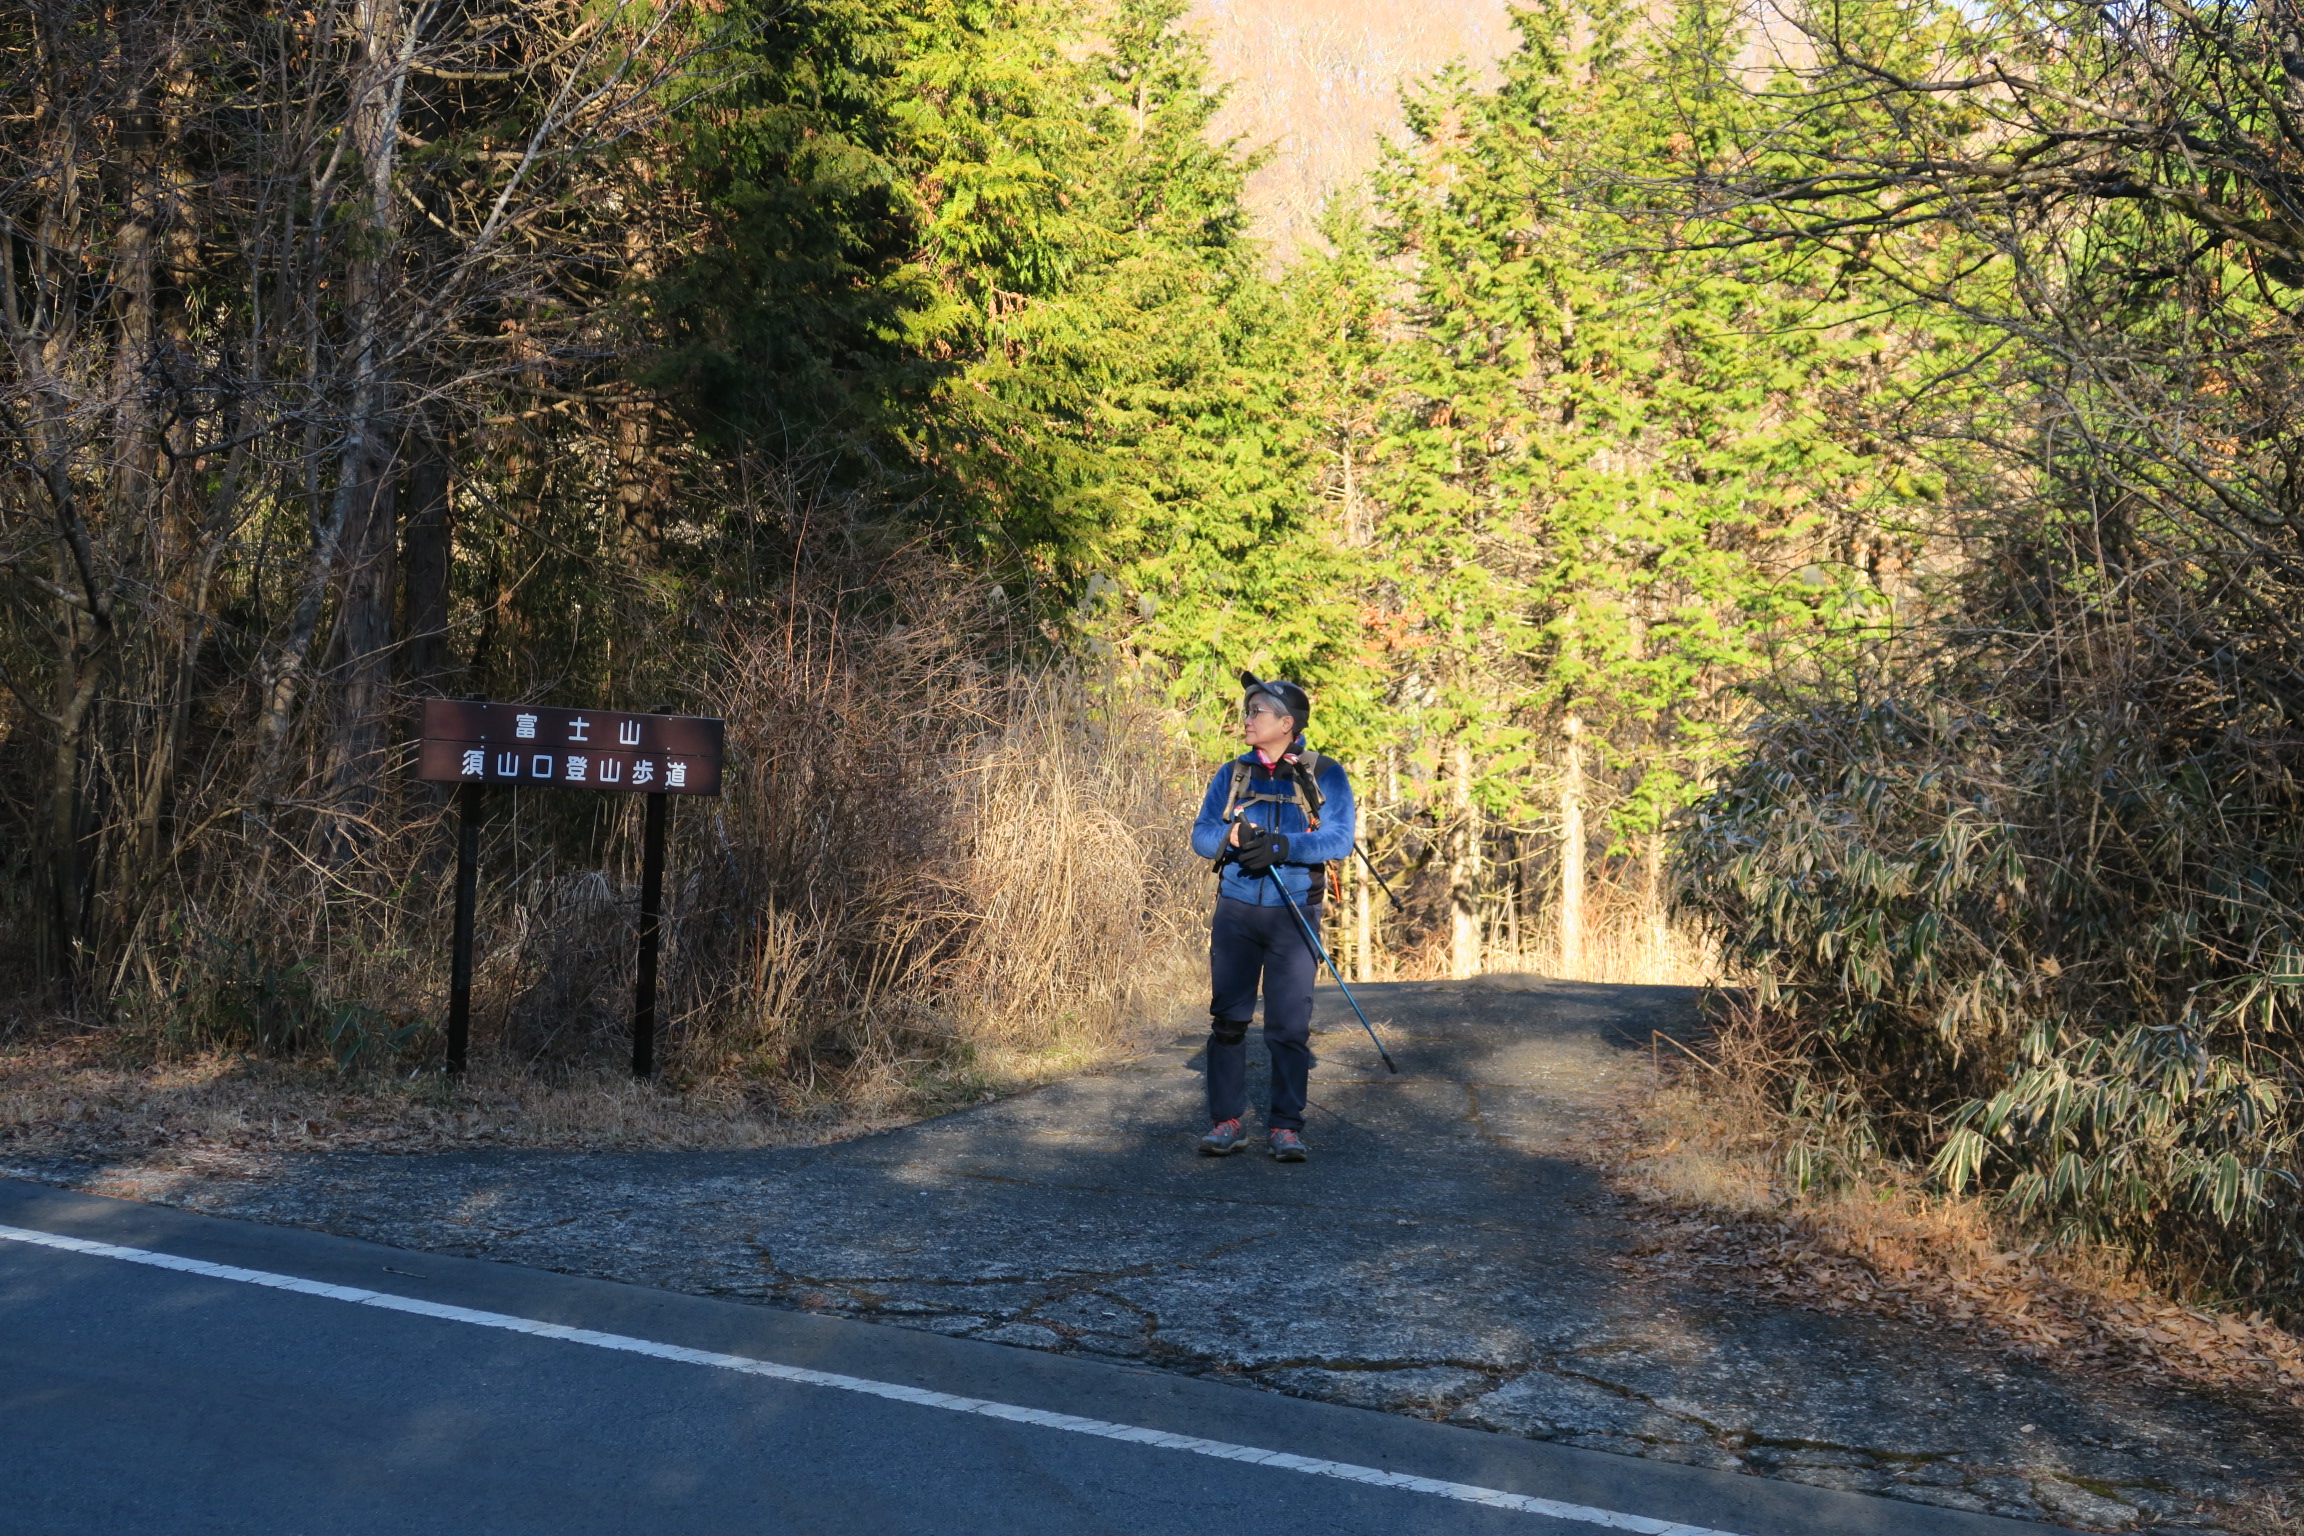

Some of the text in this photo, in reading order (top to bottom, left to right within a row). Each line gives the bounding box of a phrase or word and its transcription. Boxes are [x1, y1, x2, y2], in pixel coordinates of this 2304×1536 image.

[516, 713, 640, 745] 富士山
[461, 749, 687, 787] 須山口登山歩道
